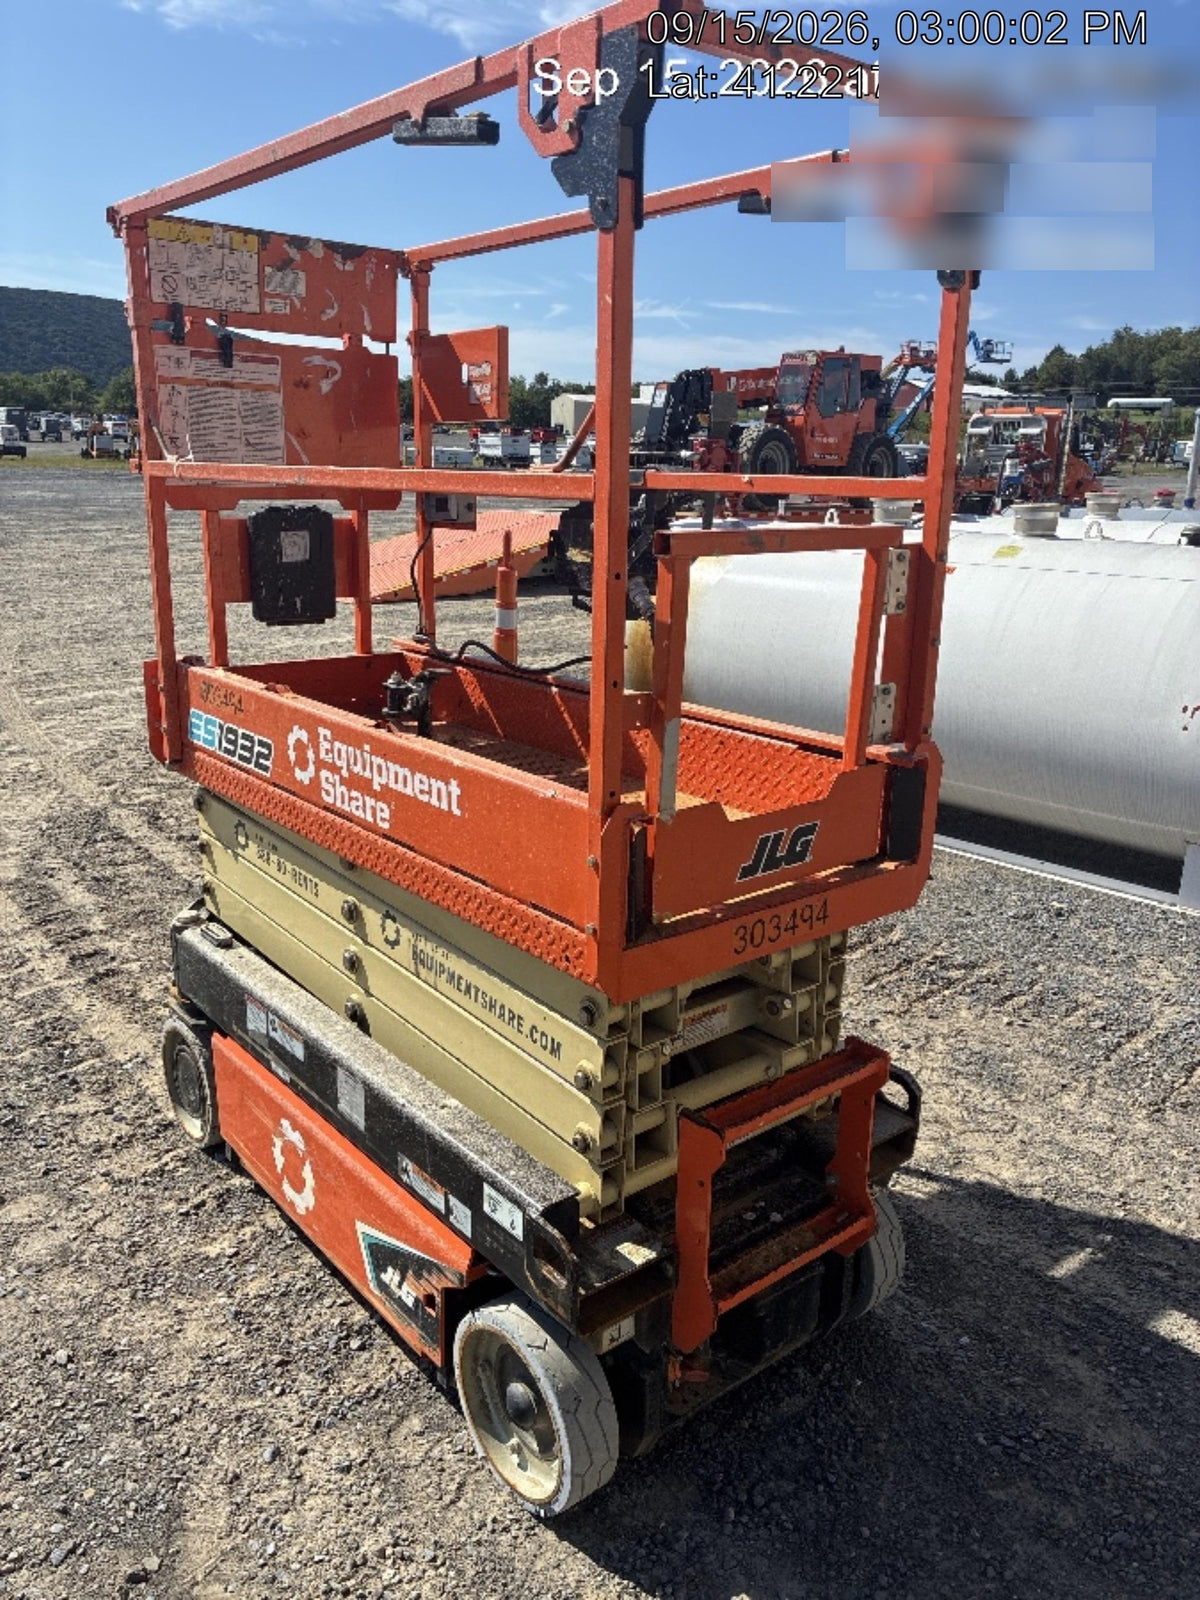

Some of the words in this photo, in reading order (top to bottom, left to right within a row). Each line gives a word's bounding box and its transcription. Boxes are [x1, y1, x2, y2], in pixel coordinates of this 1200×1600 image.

[188, 707, 274, 778] ES1932
[317, 726, 462, 817] Equipment
[319, 768, 391, 830] Share
[735, 819, 820, 883] JLG
[733, 897, 830, 956] 303494
[411, 942, 563, 1062] EQUIPMENTSHARE.COM
